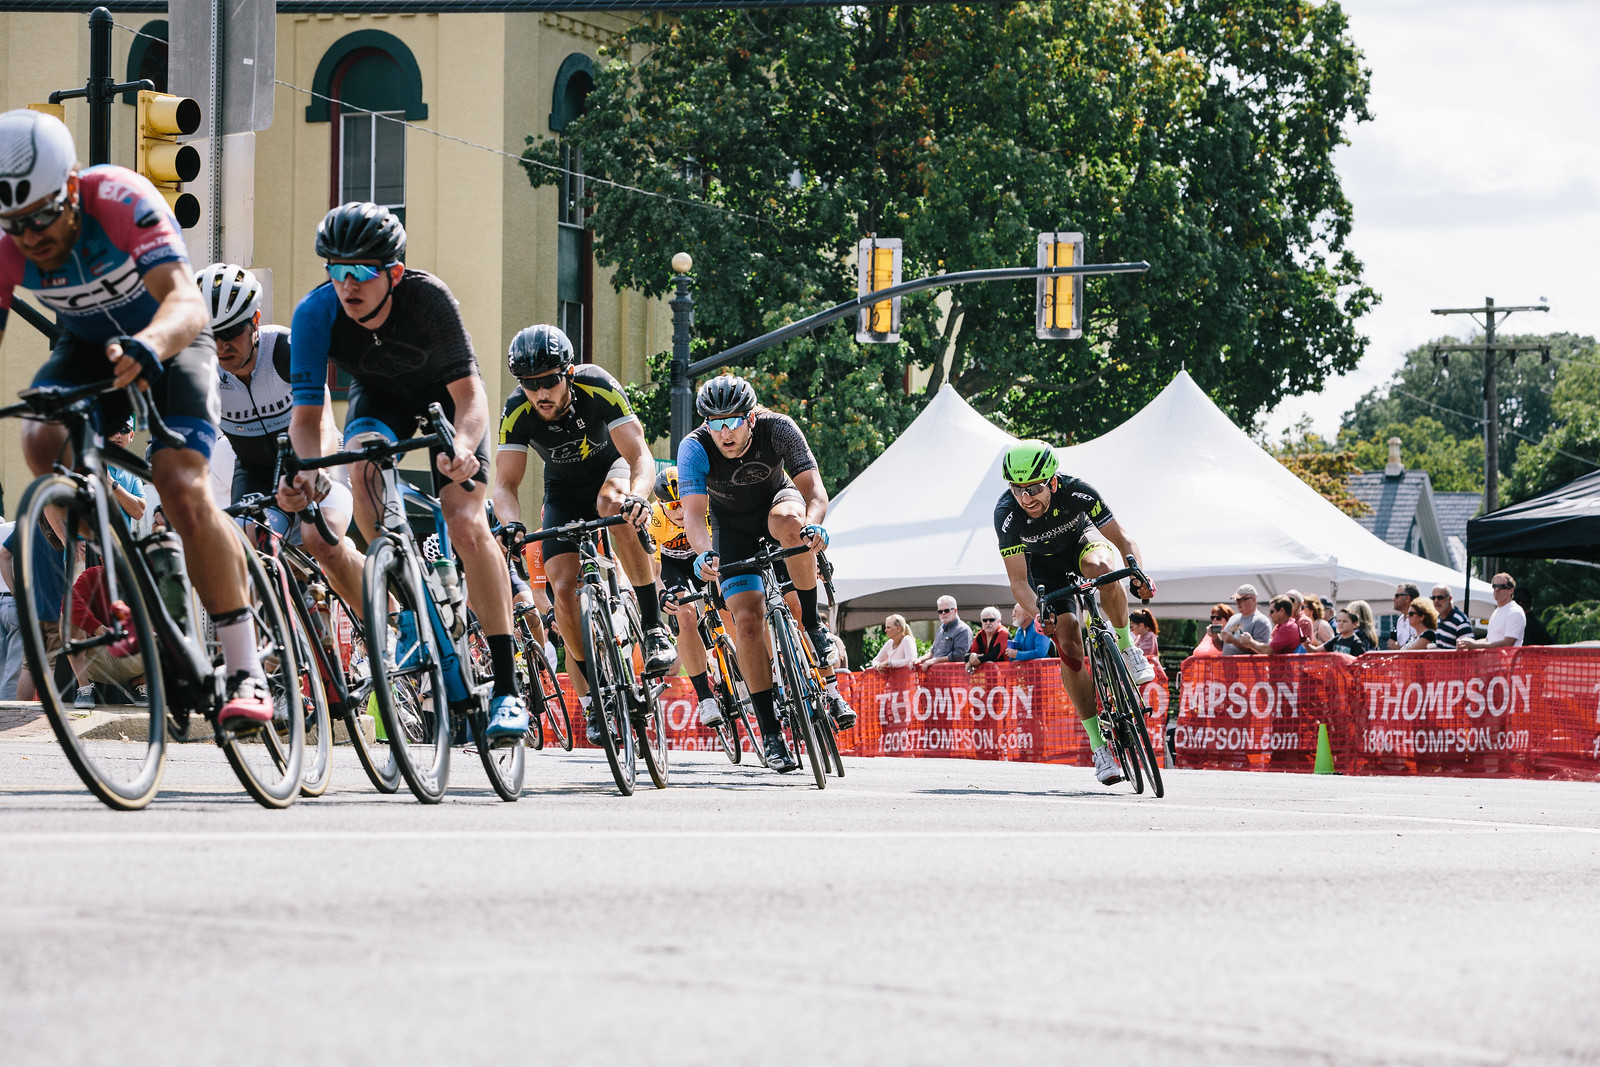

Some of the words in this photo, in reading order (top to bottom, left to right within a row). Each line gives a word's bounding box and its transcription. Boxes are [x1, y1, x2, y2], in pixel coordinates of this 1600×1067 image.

[226, 391, 293, 419] BREAKAWA
[1071, 492, 1094, 502] FELT
[1001, 511, 1014, 533] FELT
[722, 579, 748, 593] APIE
[875, 685, 1034, 725] THOMPSON
[1364, 674, 1532, 721] THOMPSON
[878, 727, 1034, 753] 1800THOMPSON.com
[1362, 726, 1530, 753] 1800THOMPSON.com
